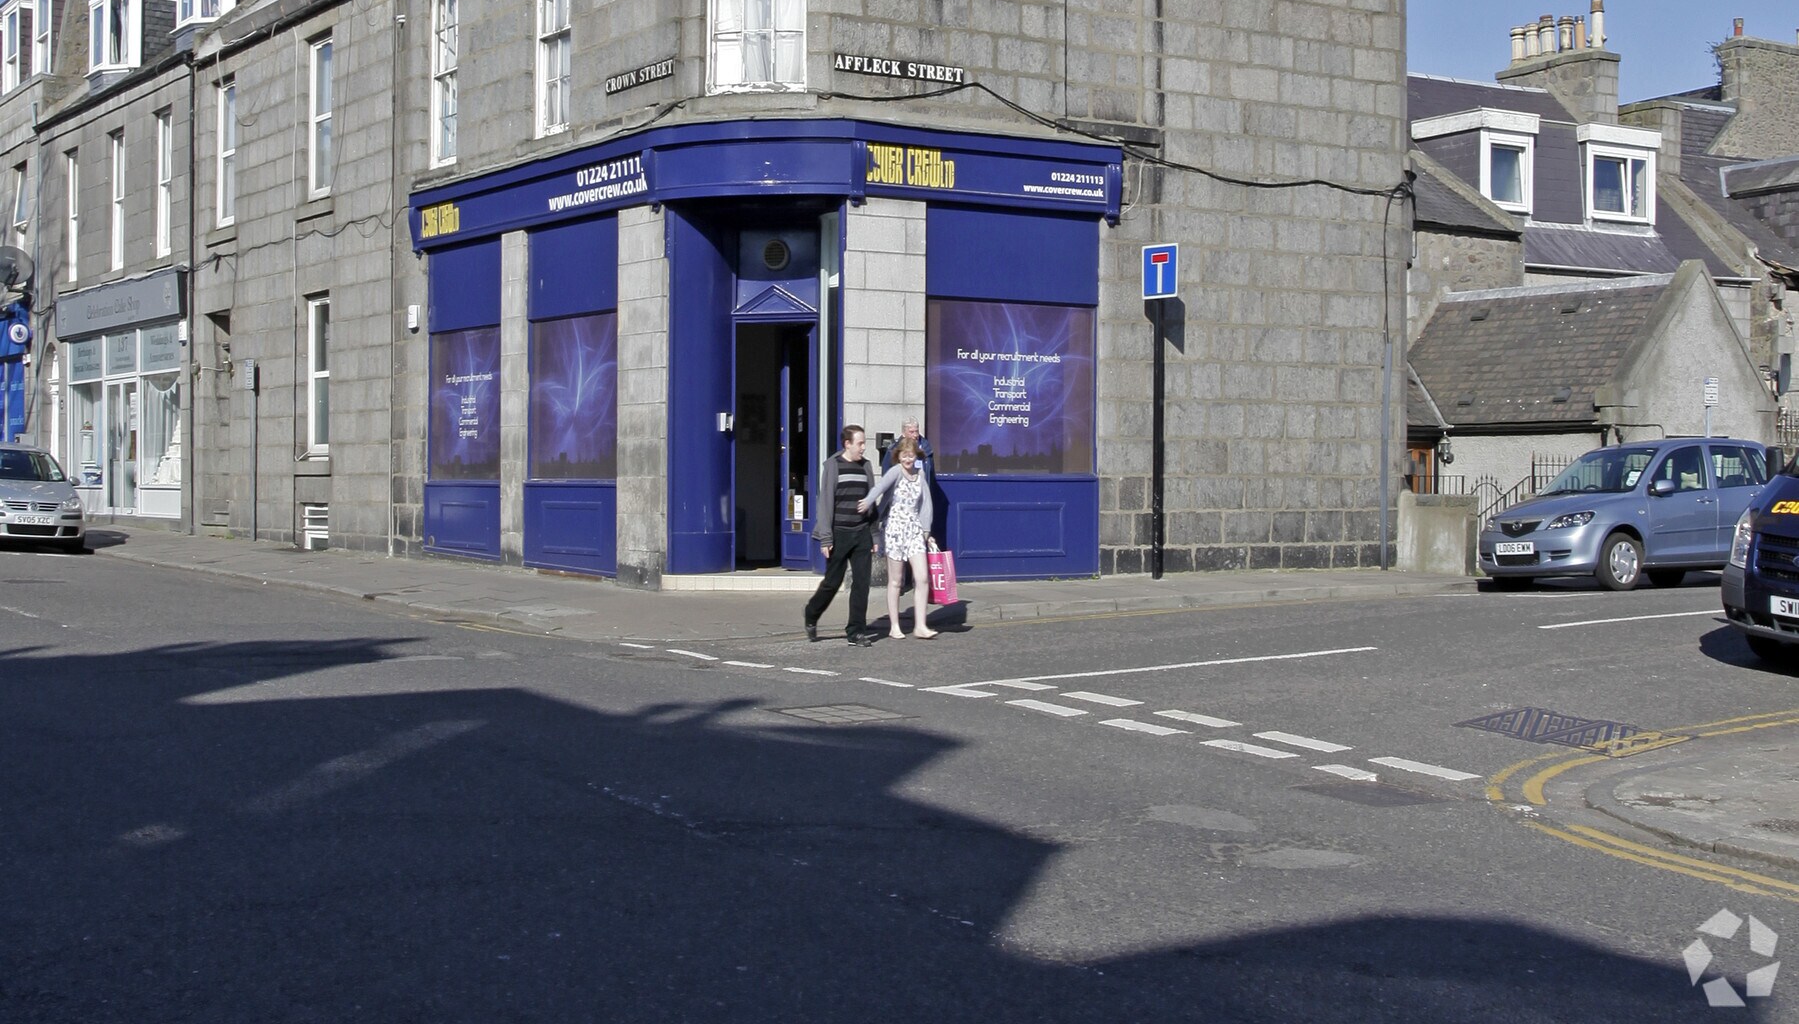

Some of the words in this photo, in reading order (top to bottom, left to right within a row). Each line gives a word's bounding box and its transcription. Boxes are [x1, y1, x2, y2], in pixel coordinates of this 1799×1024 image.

[834, 54, 901, 76] AFFLECK
[907, 62, 964, 83] STREET
[605, 70, 637, 93] CROWN
[639, 59, 673, 82] STREET
[576, 164, 608, 187] 01224
[609, 156, 644, 180] 21111
[1051, 172, 1075, 183] 01224
[1075, 174, 1104, 185] 211113
[548, 172, 648, 212] www.covercrew.co.uk
[1023, 184, 1104, 197] www.covercrew.co.uk
[957, 349, 970, 359] For
[970, 350, 978, 360] all
[979, 353, 997, 363] your
[997, 351, 1039, 362] recruitment
[1039, 353, 1061, 363] needs
[993, 376, 1026, 387] Industrial
[992, 387, 1027, 401] Transport
[988, 400, 1031, 412] Commercial
[989, 413, 1029, 427] Engineering
[932, 574, 946, 591] LE
